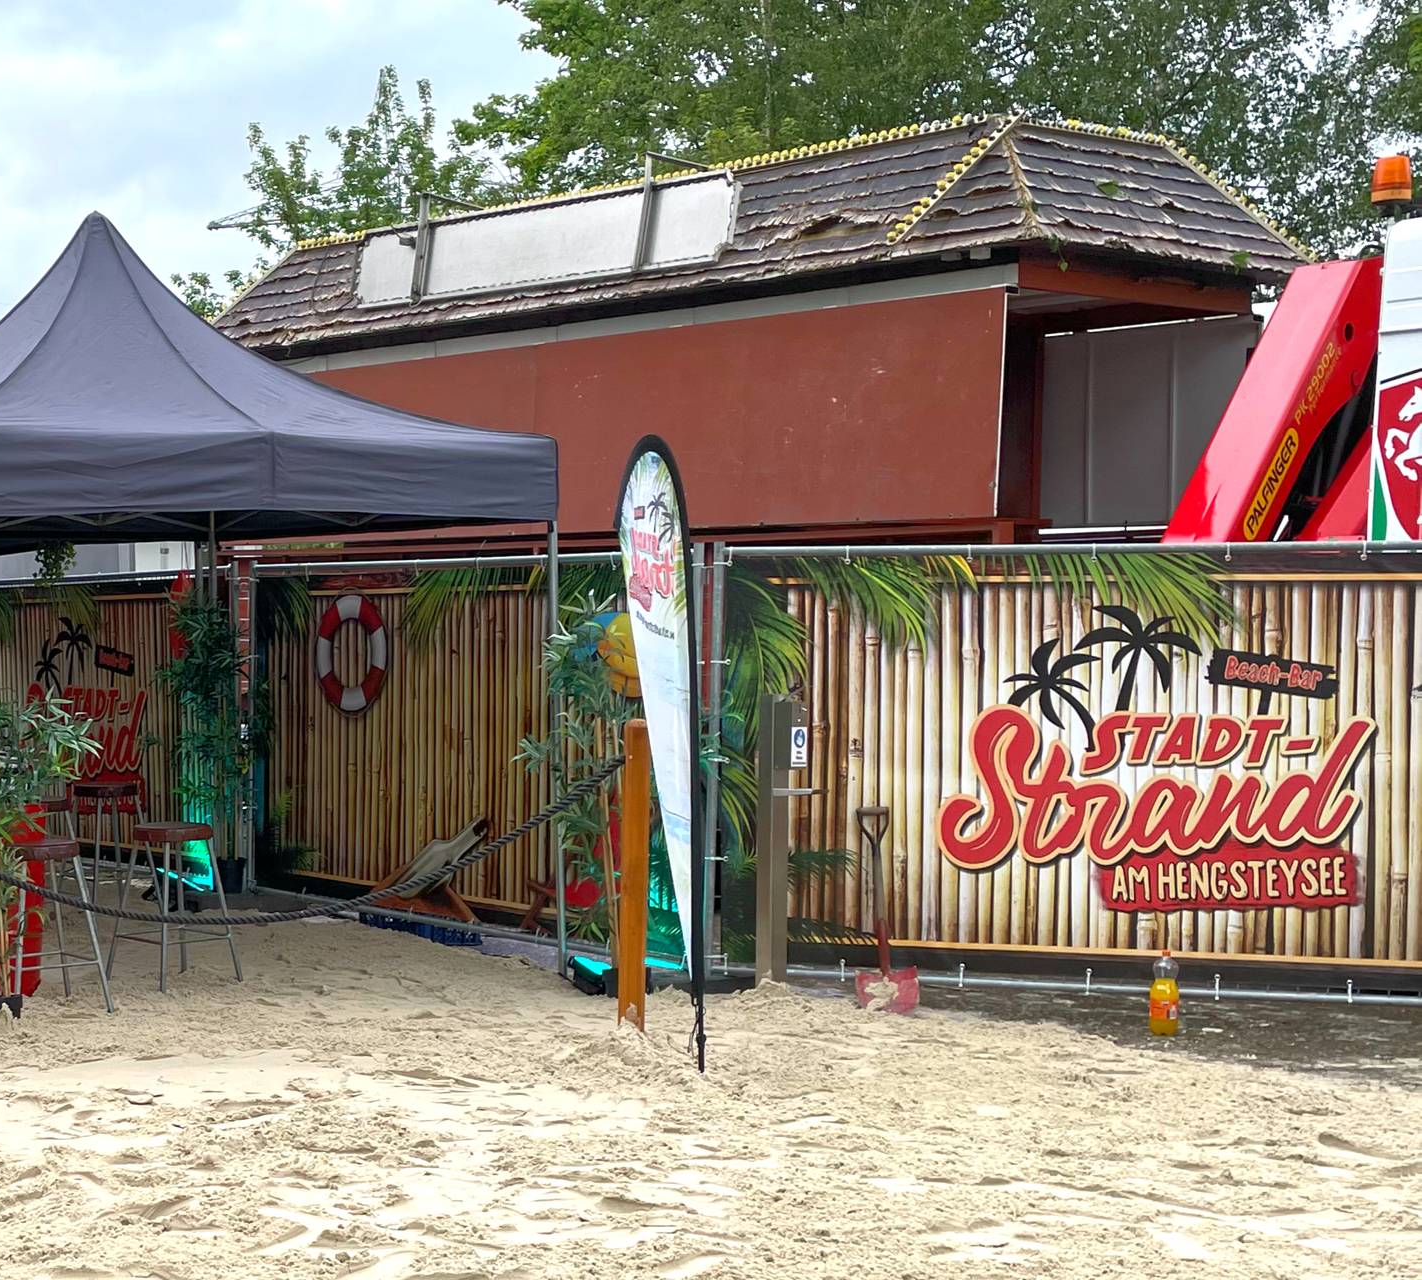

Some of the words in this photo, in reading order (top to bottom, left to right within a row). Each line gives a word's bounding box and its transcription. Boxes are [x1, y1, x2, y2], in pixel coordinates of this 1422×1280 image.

[1294, 400, 1310, 425] PK
[1306, 341, 1336, 401] 29002
[1247, 434, 1296, 535] PALFINGER
[1224, 655, 1323, 691] Beach-Bar
[1080, 711, 1321, 774] STADT-
[938, 705, 1376, 869] Strand
[1111, 862, 1152, 902] AM
[1157, 856, 1348, 903] HENGSTEYSEE
